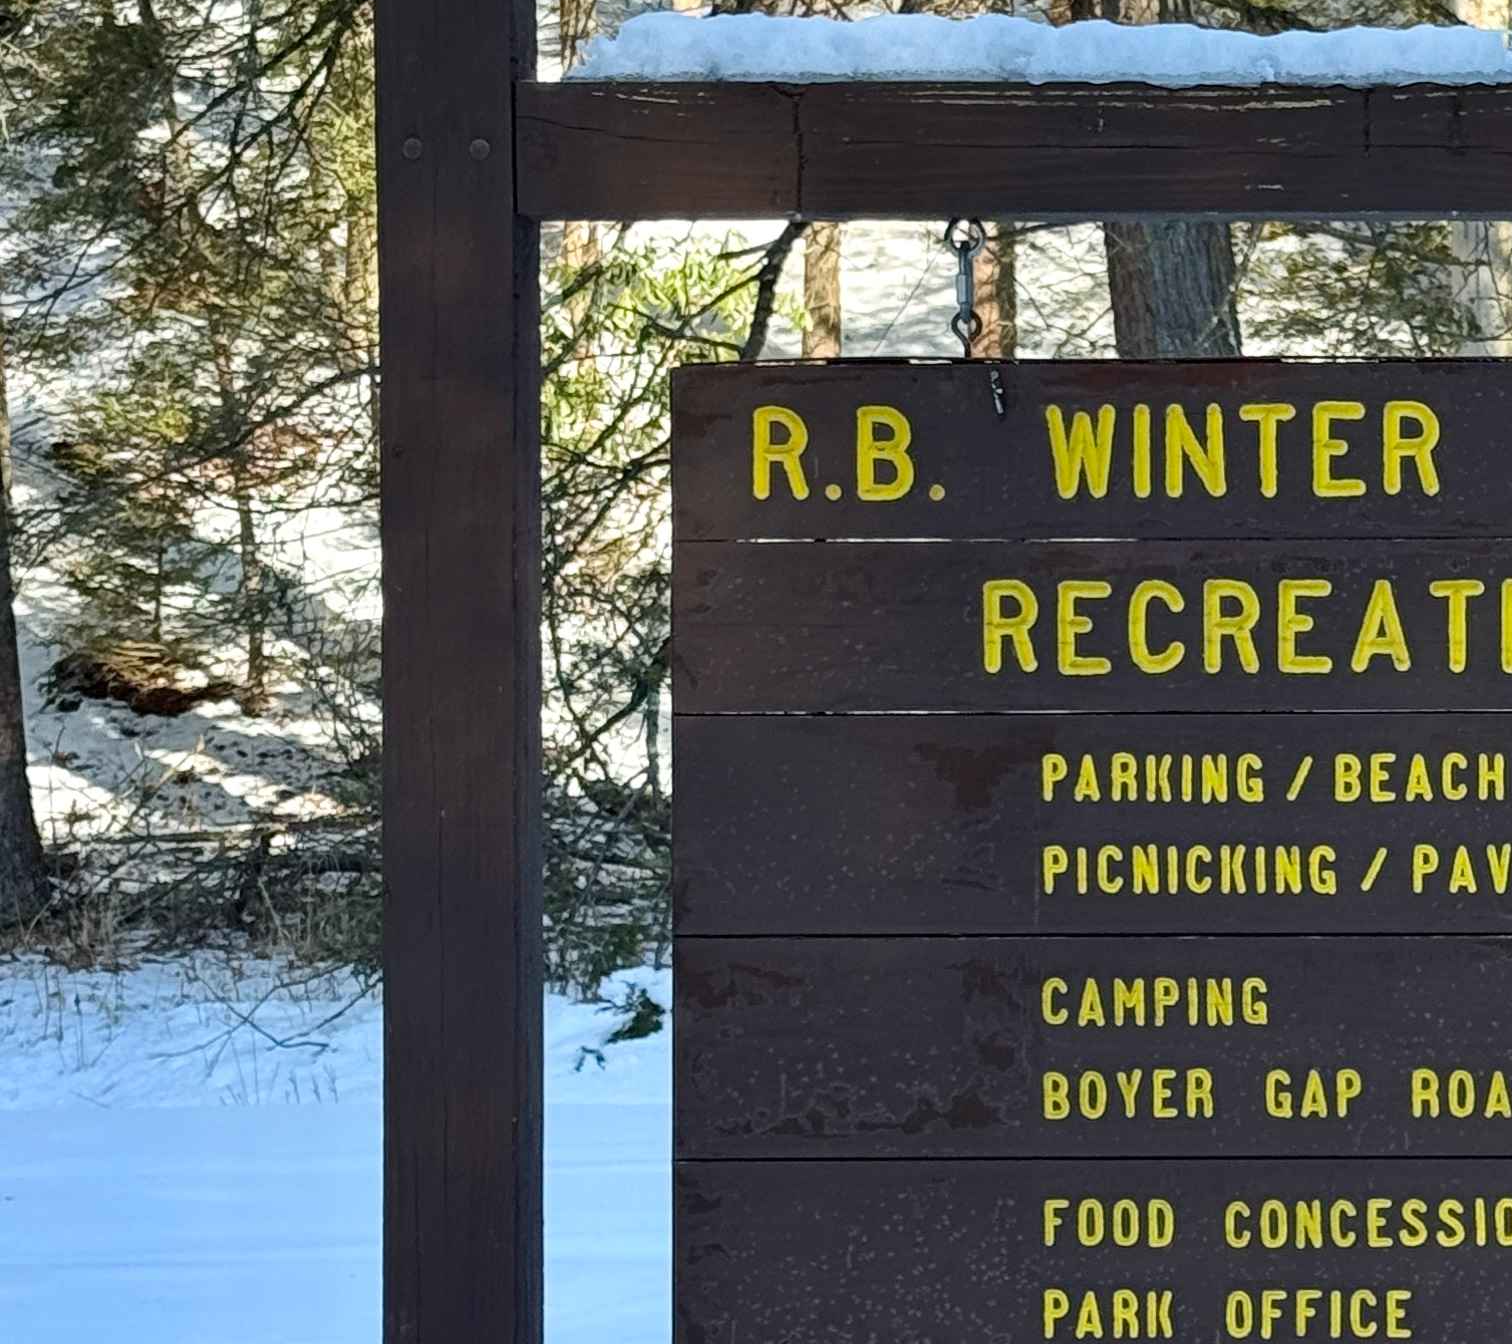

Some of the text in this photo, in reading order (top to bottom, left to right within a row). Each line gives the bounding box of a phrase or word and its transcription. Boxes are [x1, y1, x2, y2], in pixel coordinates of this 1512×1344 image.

[751, 404, 945, 503] R.B.
[1043, 399, 1443, 500] WINTER
[1040, 750, 1267, 804] PARKING
[1333, 750, 1507, 804] BEACH
[1041, 843, 1339, 896] PICNICKING
[1040, 975, 1270, 1027] CAMPING
[1041, 1066, 1216, 1121] BOYER
[1263, 1067, 1364, 1119] GAP
[1042, 1197, 1177, 1249] FOOD
[1042, 1287, 1411, 1340] PARK OFFICE
